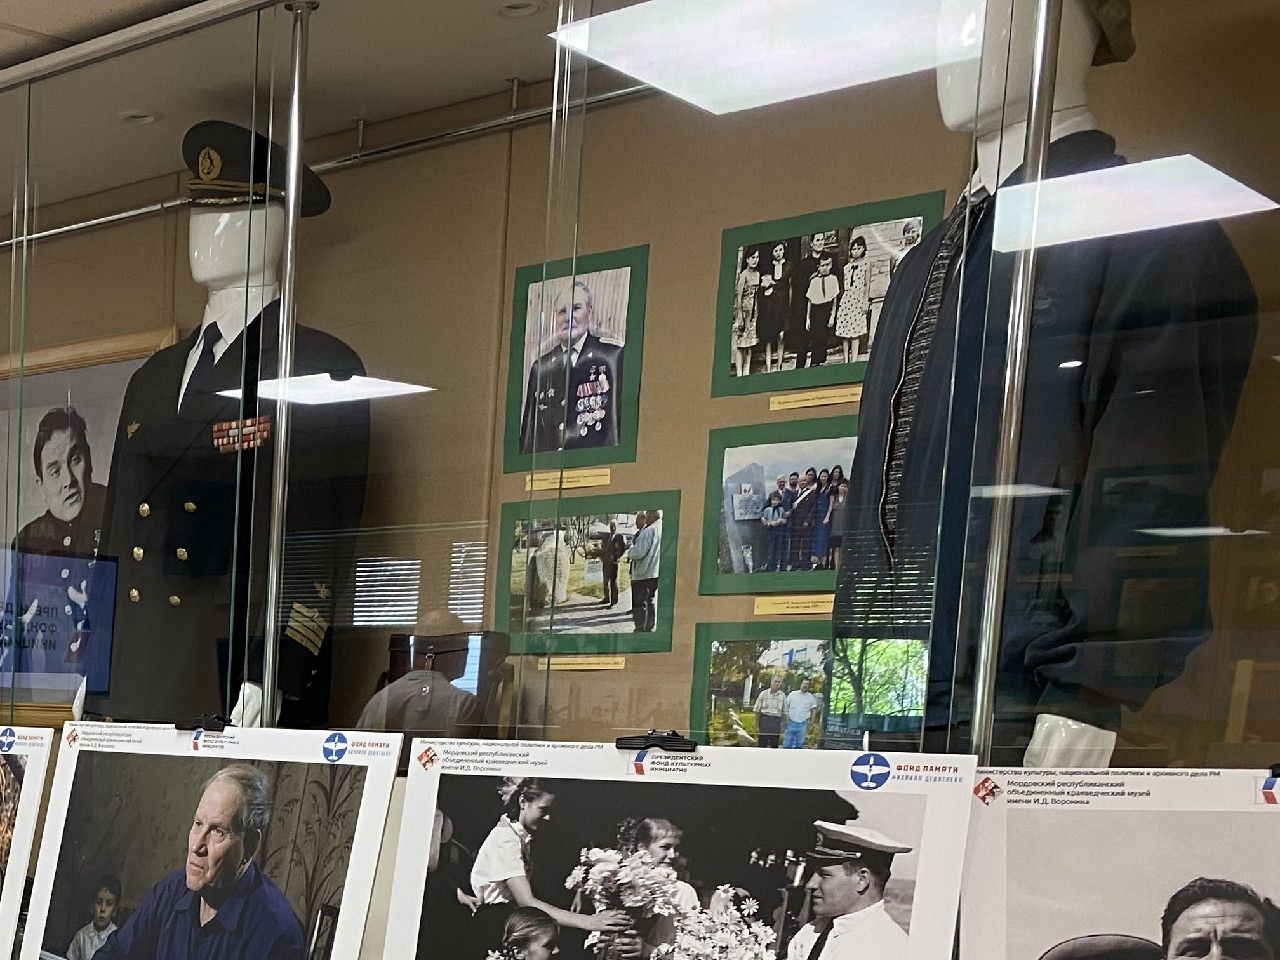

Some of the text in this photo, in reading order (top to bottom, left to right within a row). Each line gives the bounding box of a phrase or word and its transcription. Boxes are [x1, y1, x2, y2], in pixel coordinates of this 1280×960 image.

[896, 764, 959, 773] ФОНД ПАМЯТИ
[1006, 780, 1125, 789] Мордовский республиканский
[1127, 789, 1151, 798] музей
[1050, 798, 1090, 806] Воронина
